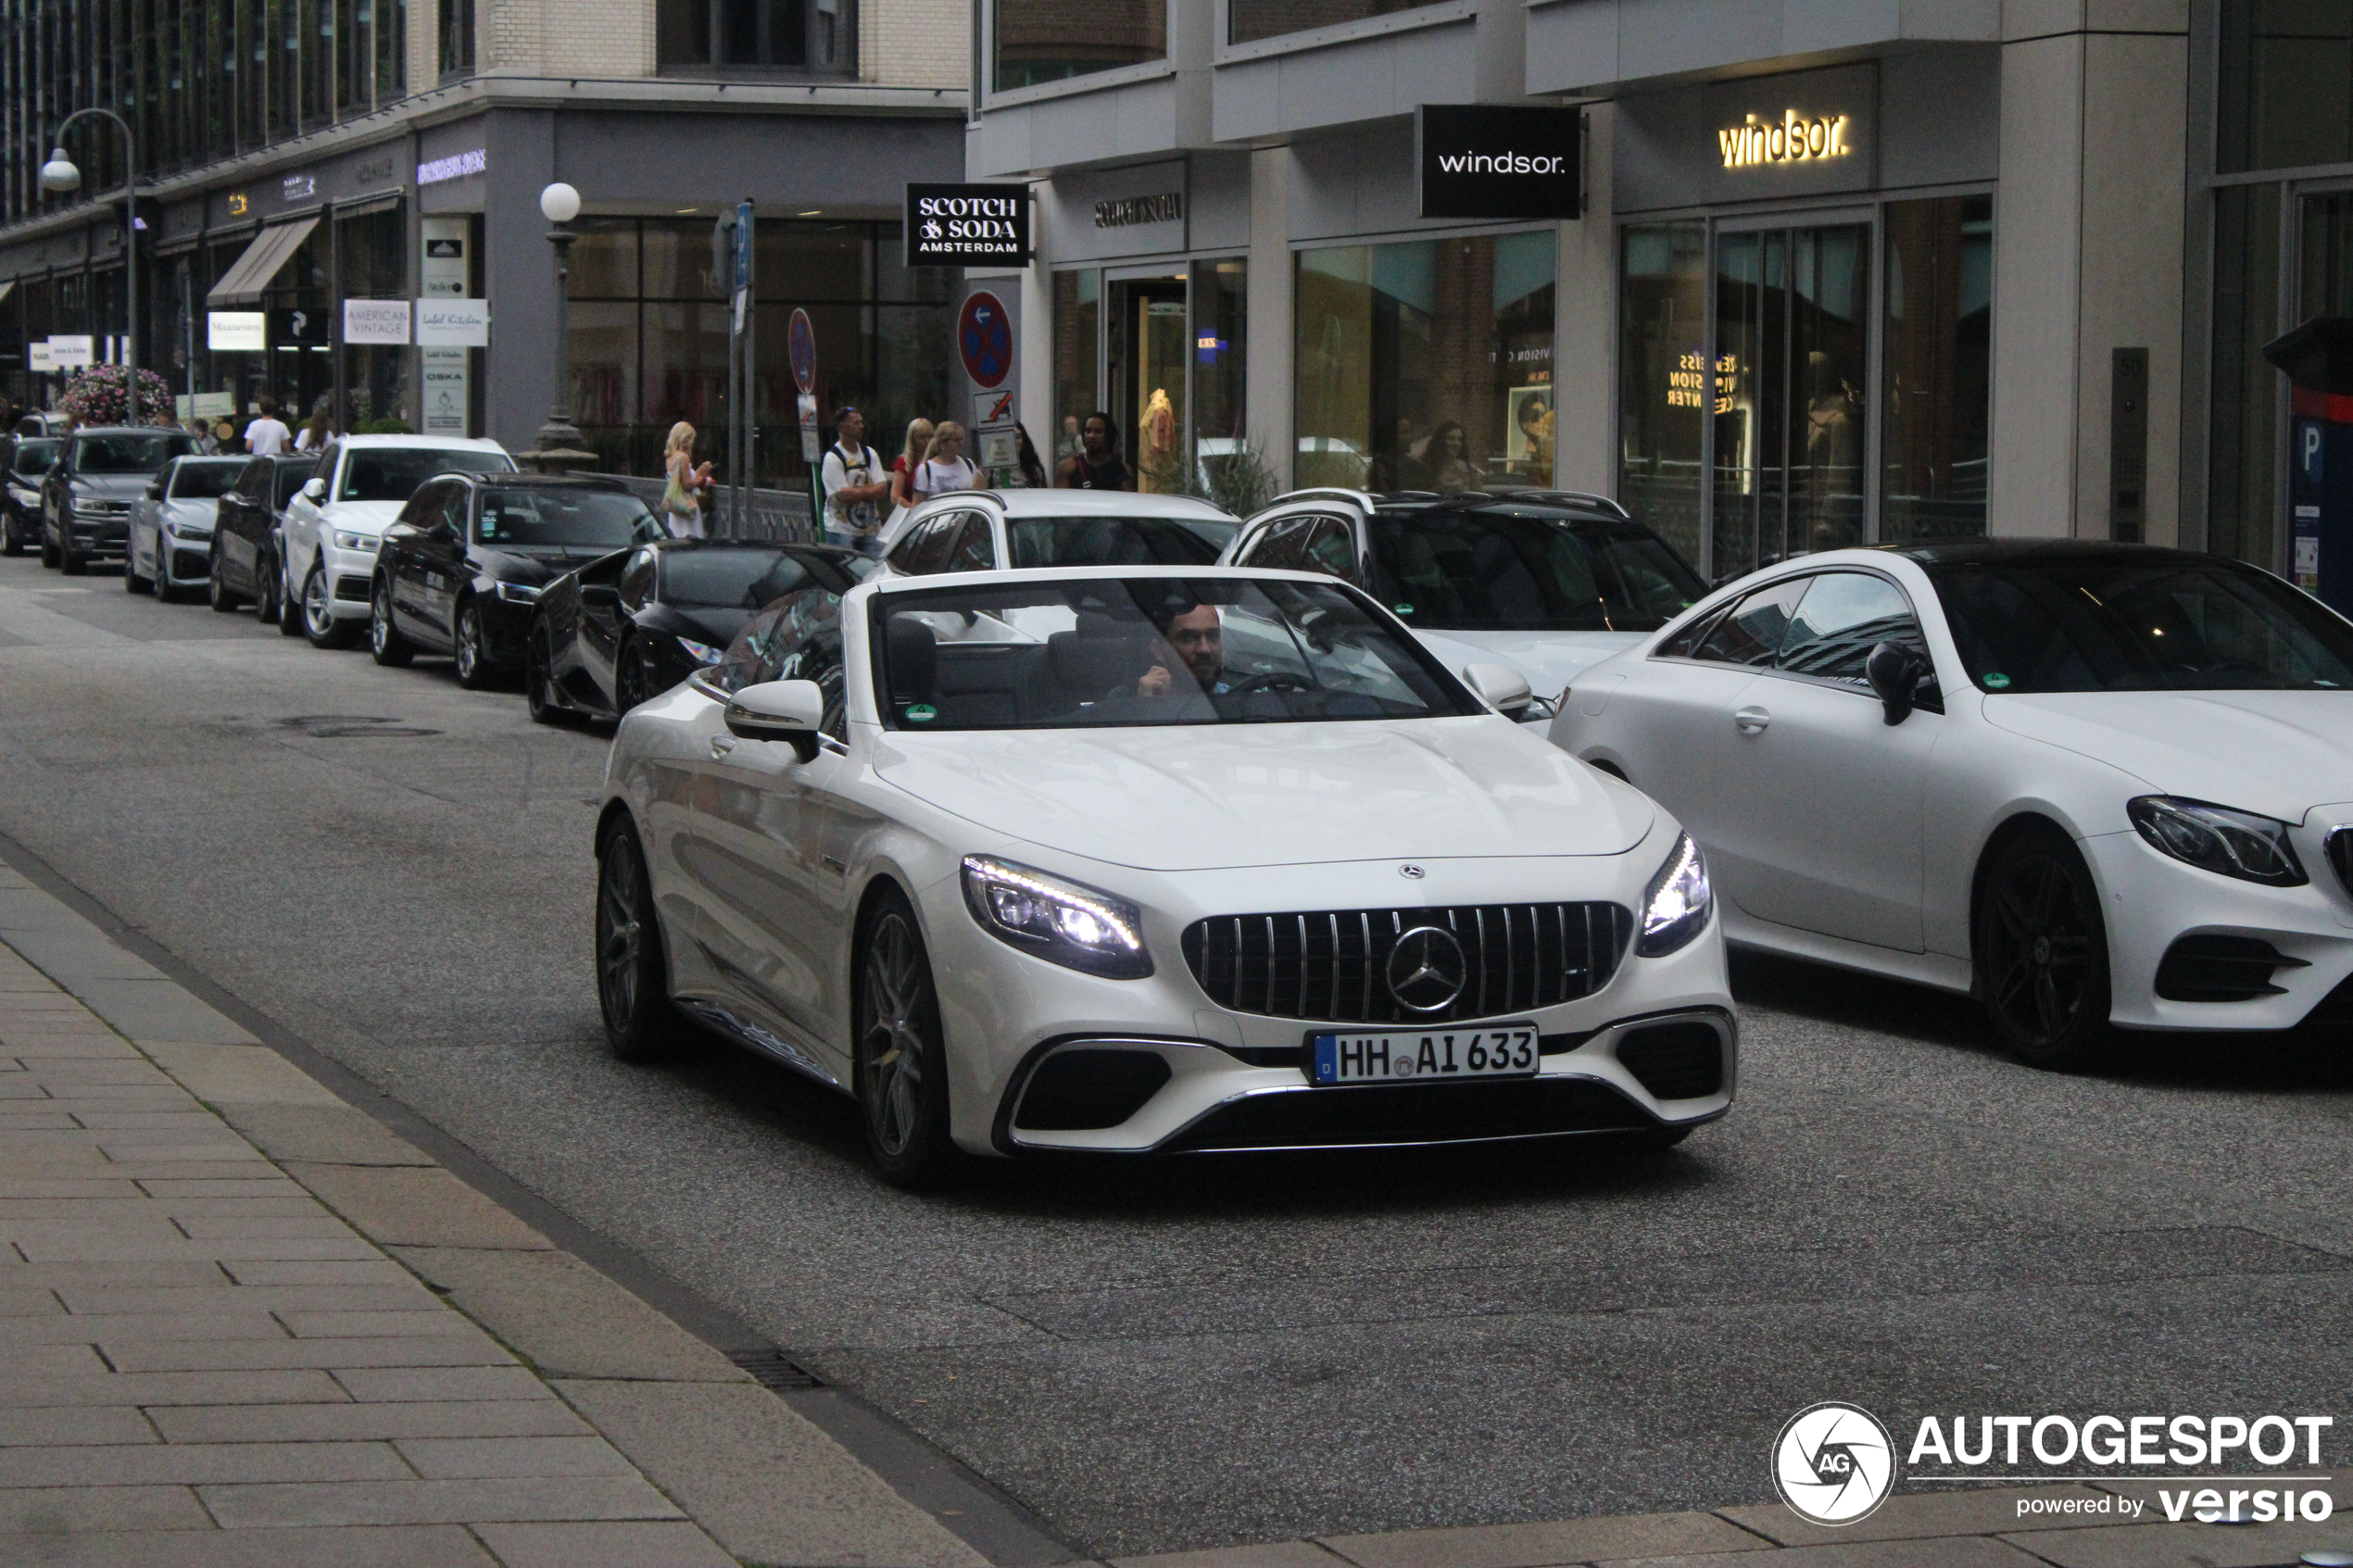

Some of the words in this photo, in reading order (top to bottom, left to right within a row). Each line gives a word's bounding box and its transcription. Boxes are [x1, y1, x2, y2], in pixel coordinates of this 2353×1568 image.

[1719, 108, 1849, 169] windsor.
[1439, 150, 1566, 174] windsor.
[919, 197, 1016, 217] SCOTCH
[919, 218, 943, 239] &
[949, 220, 1017, 238] SODA
[919, 242, 1018, 253] AMSTERDAM
[348, 309, 408, 321] AMERICAN
[422, 313, 445, 324] Label
[447, 313, 482, 324] Kitchen
[353, 322, 402, 334] VINTAGE
[426, 372, 462, 381] OSKA
[2305, 427, 2321, 470] P
[1340, 1038, 1390, 1076] HH
[1416, 1035, 1458, 1073] AI
[1468, 1032, 1532, 1071] 633
